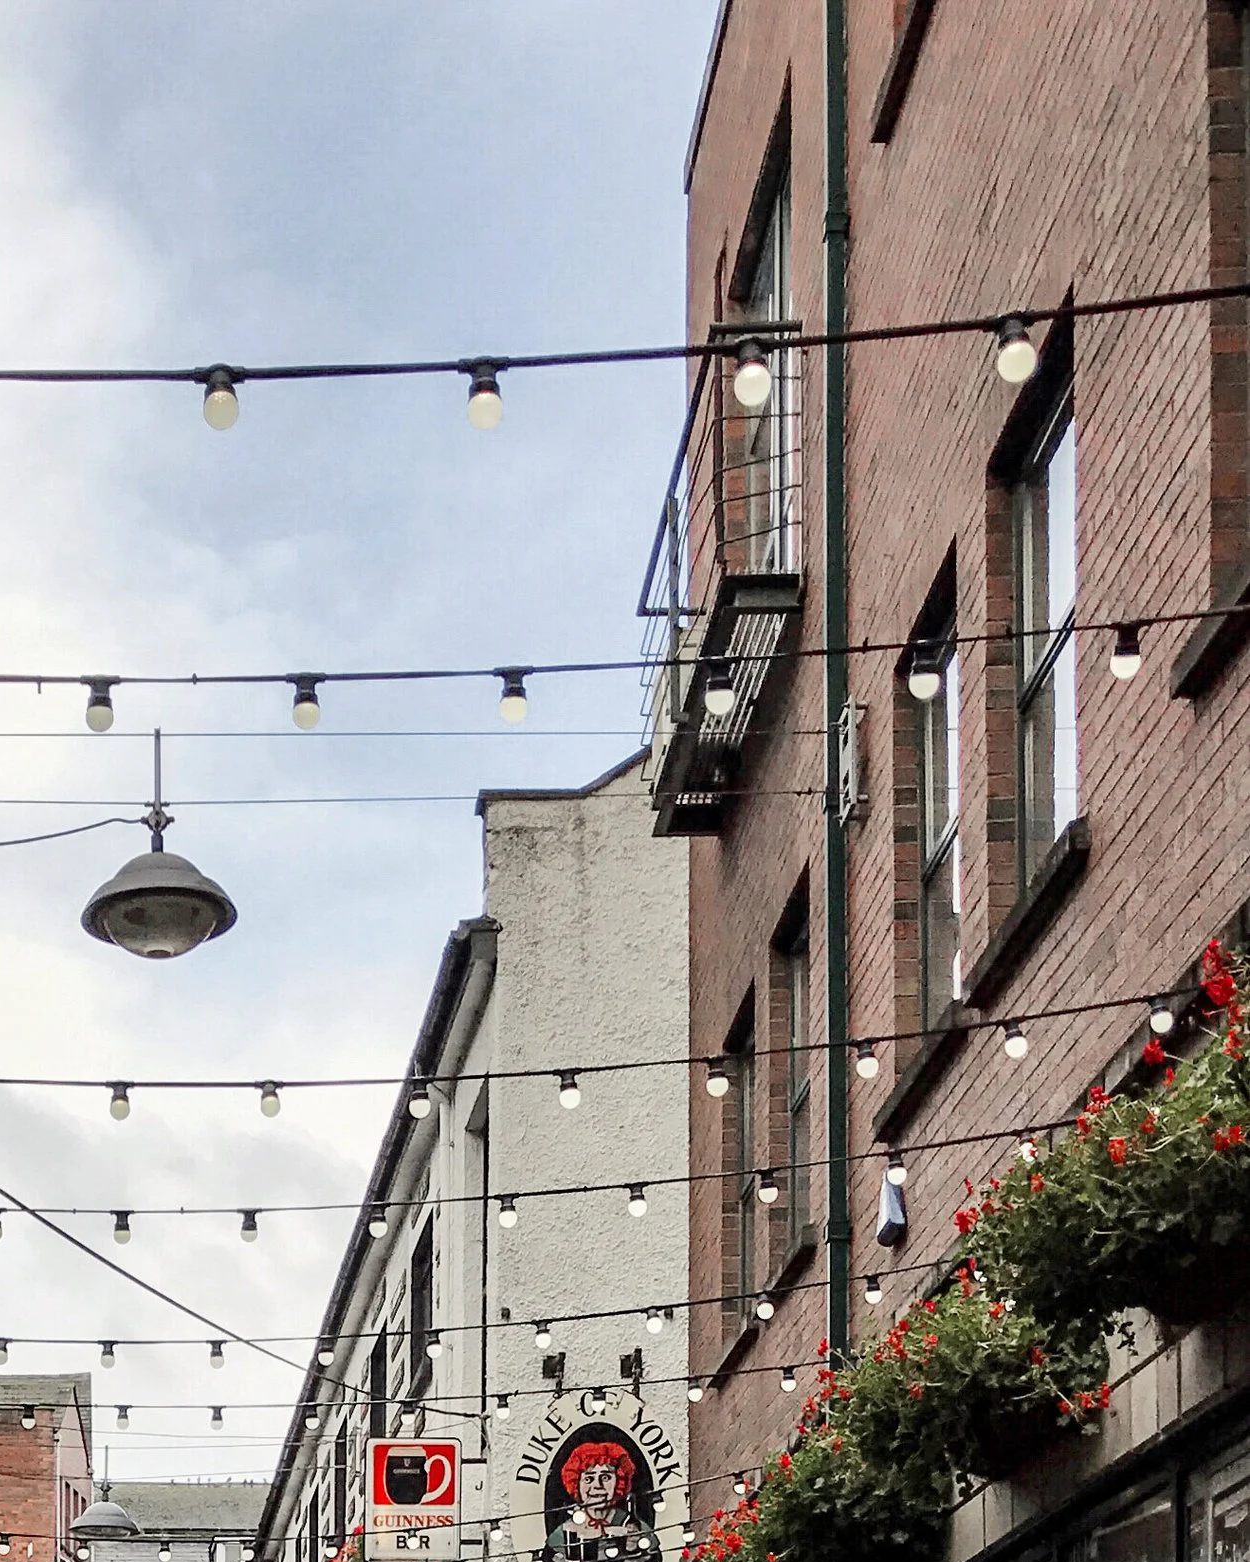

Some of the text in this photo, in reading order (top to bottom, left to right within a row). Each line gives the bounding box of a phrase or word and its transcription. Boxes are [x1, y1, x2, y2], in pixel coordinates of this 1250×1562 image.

[516, 1407, 573, 1485] DUKE
[630, 1406, 683, 1485] YORK
[373, 1514, 454, 1528] GUINNESS
[396, 1535, 430, 1549] BR
